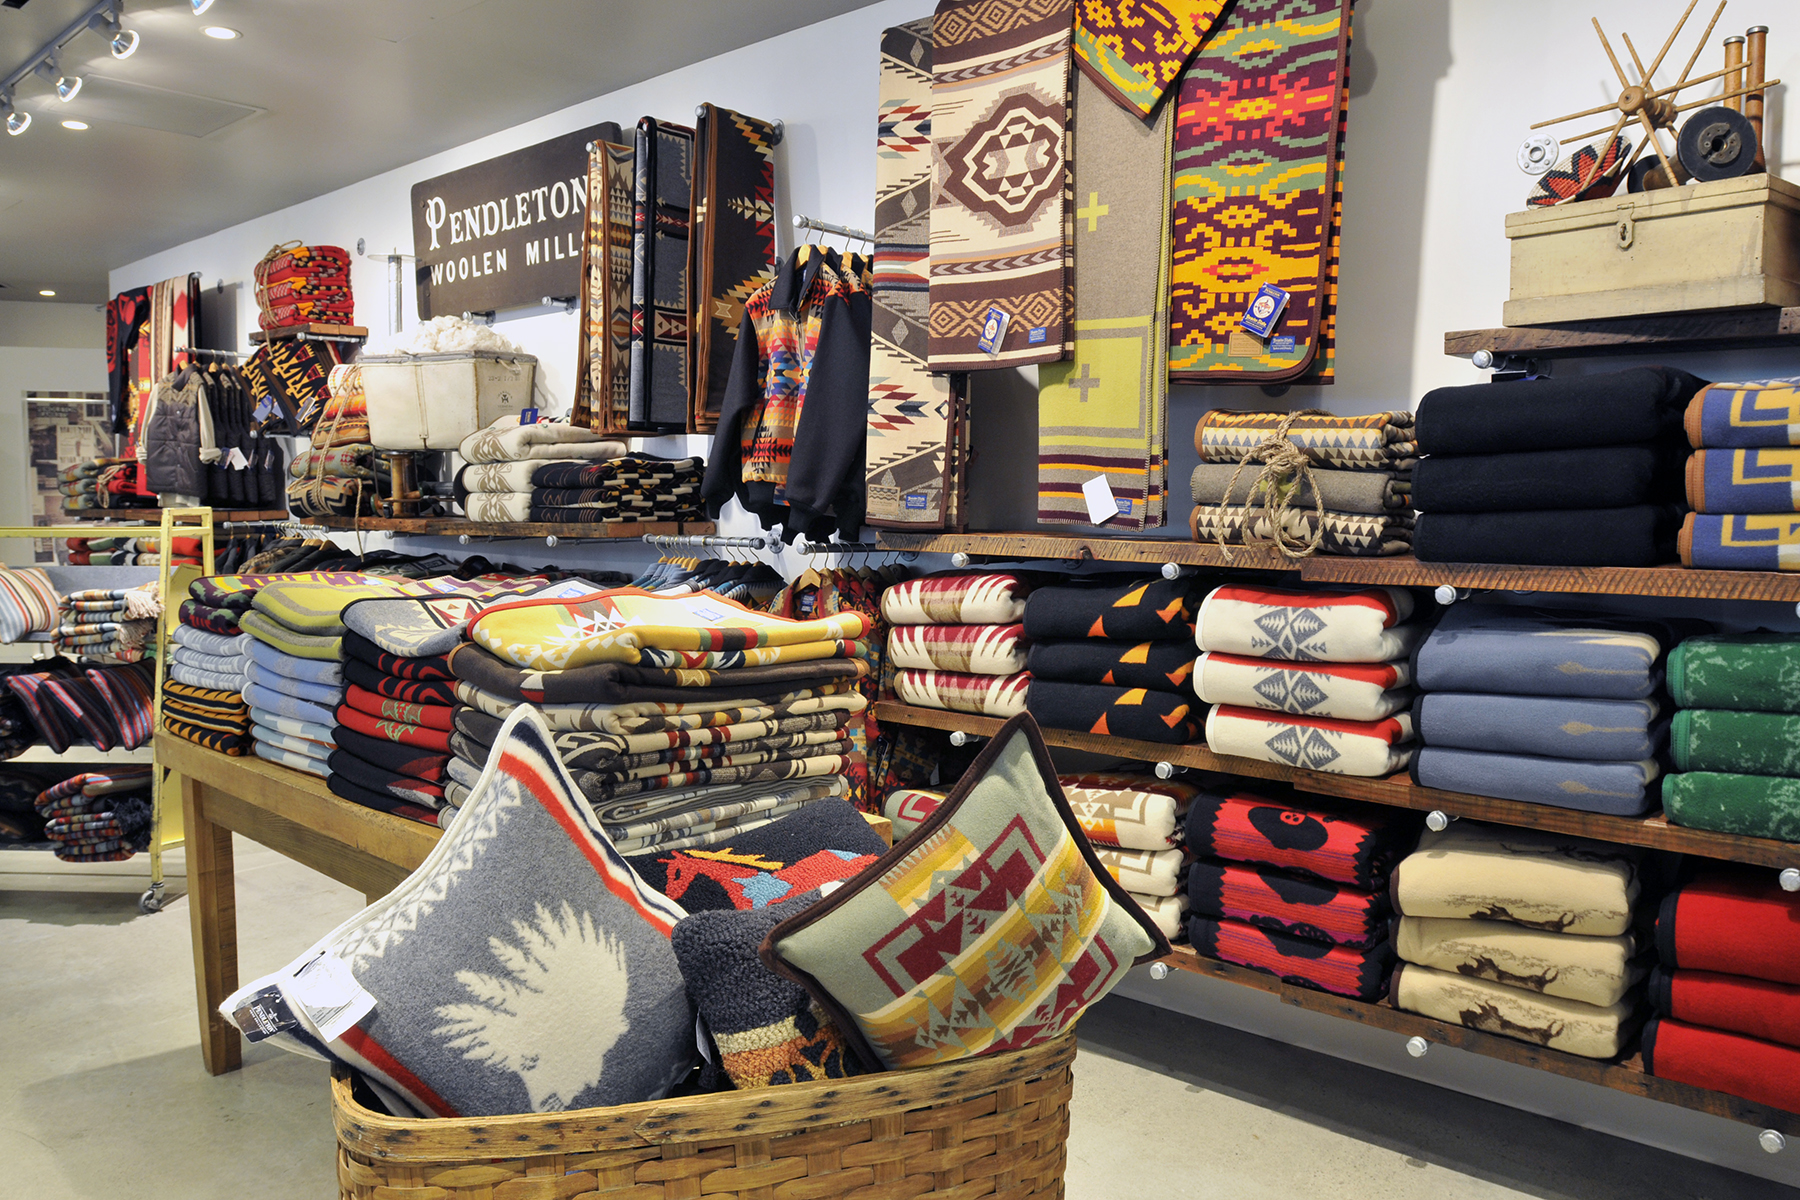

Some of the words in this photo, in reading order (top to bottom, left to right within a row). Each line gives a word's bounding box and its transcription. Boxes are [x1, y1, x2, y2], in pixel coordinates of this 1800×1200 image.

[425, 174, 588, 251] PENDLETON
[430, 248, 507, 286] WOOLEN
[526, 230, 585, 266] MILL
